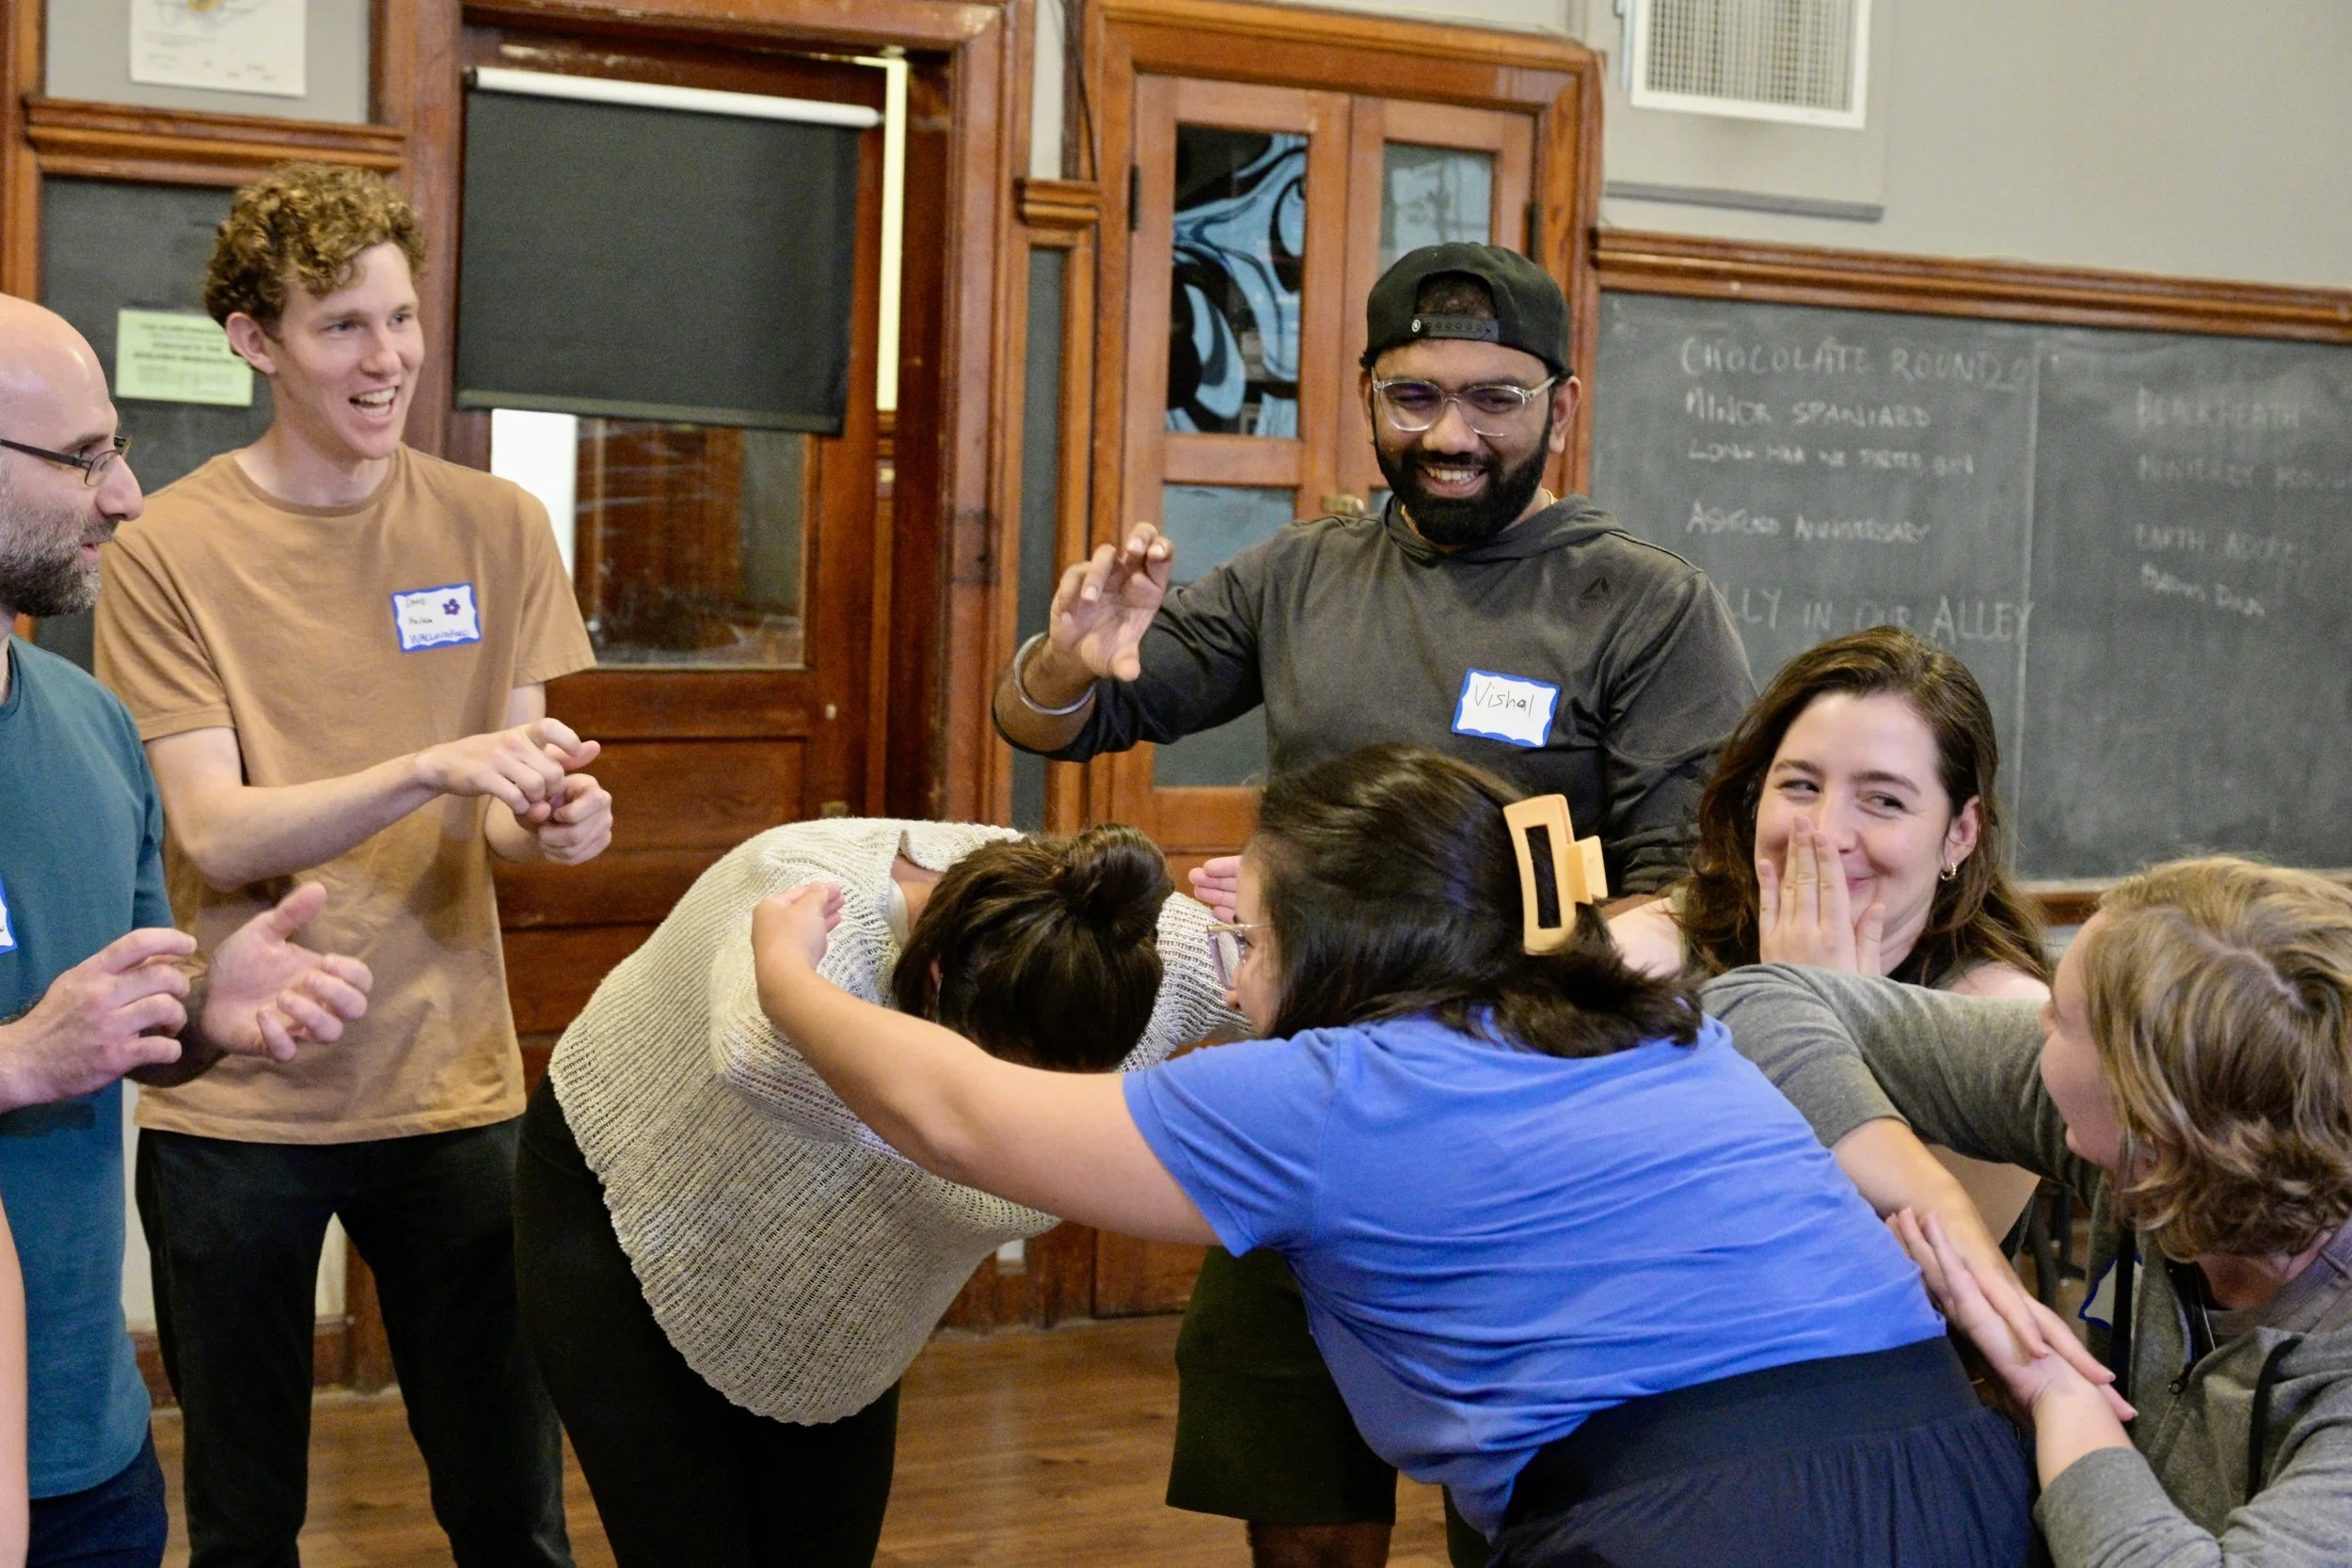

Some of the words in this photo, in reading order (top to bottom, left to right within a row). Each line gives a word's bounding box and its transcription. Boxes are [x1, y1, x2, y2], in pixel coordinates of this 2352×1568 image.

[1679, 335, 1873, 376] CHOCOLATE
[1791, 400, 1931, 429] SPANIARD
[1803, 601, 1833, 631] IN
[1929, 594, 2035, 645] ALLEY
[1474, 681, 1534, 718] Vishal
